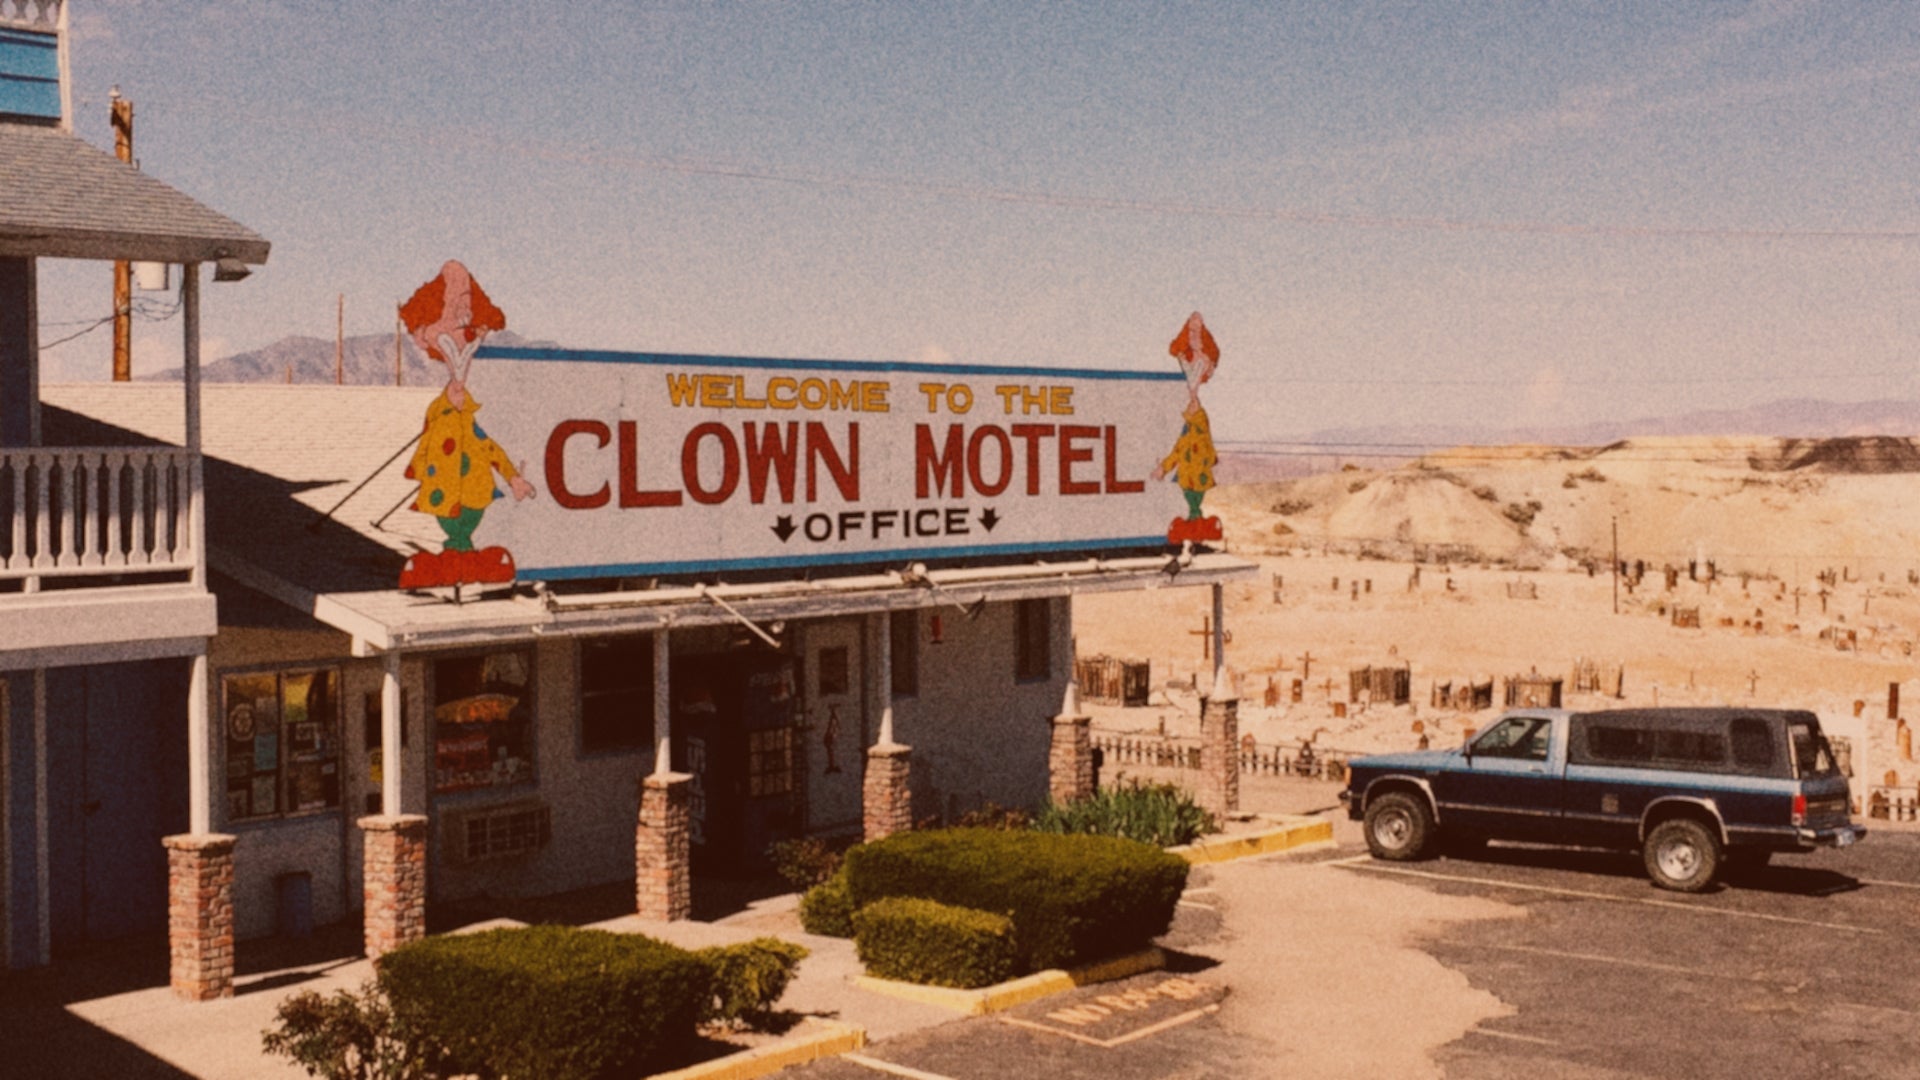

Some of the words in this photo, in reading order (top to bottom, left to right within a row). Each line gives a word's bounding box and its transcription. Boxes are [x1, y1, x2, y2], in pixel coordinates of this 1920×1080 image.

[666, 373, 890, 413] WELCOME
[918, 382, 974, 415] TO
[994, 384, 1075, 416] THE
[544, 419, 861, 510] CLOWN
[914, 422, 1145, 499] MOTEL
[803, 507, 971, 543] OFFICE
